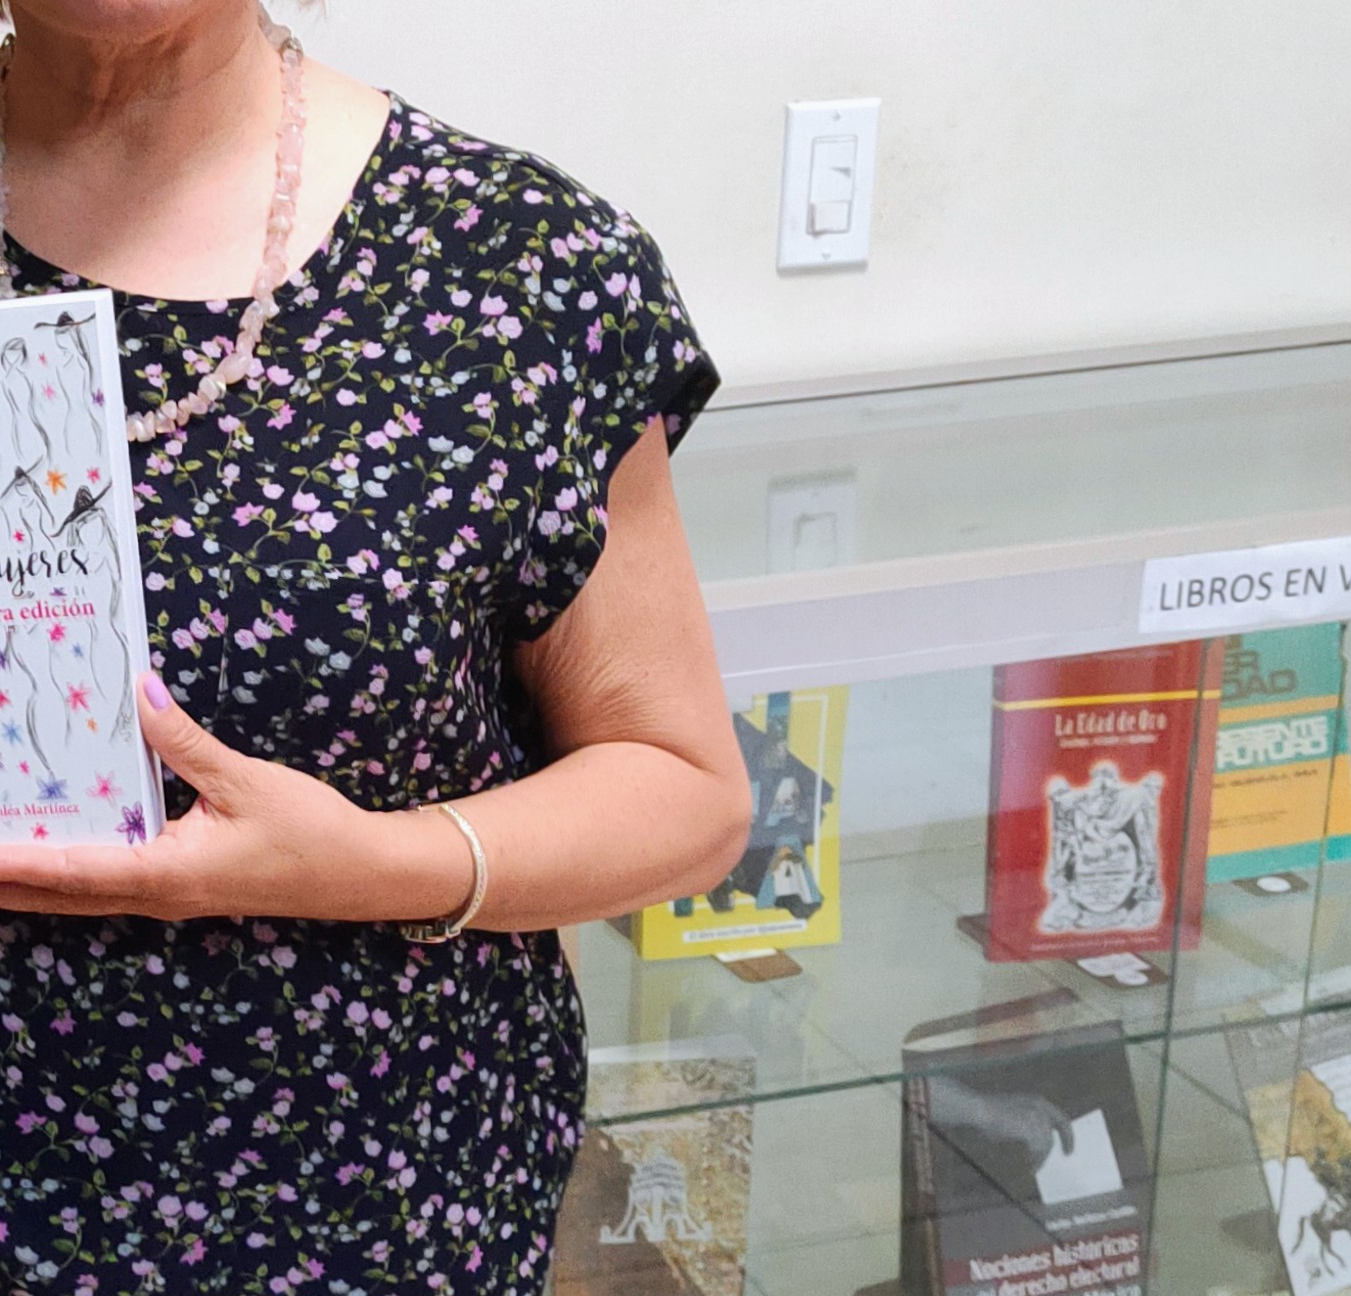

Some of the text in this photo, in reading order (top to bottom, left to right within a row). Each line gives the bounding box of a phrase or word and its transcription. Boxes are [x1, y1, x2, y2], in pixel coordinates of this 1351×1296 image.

[1159, 571, 1273, 612] LIBROS
[1284, 566, 1327, 598] EN
[19, 600, 95, 621] edición
[1054, 714, 1074, 737] La
[1076, 710, 1115, 735] Edad
[1116, 710, 1136, 732] de
